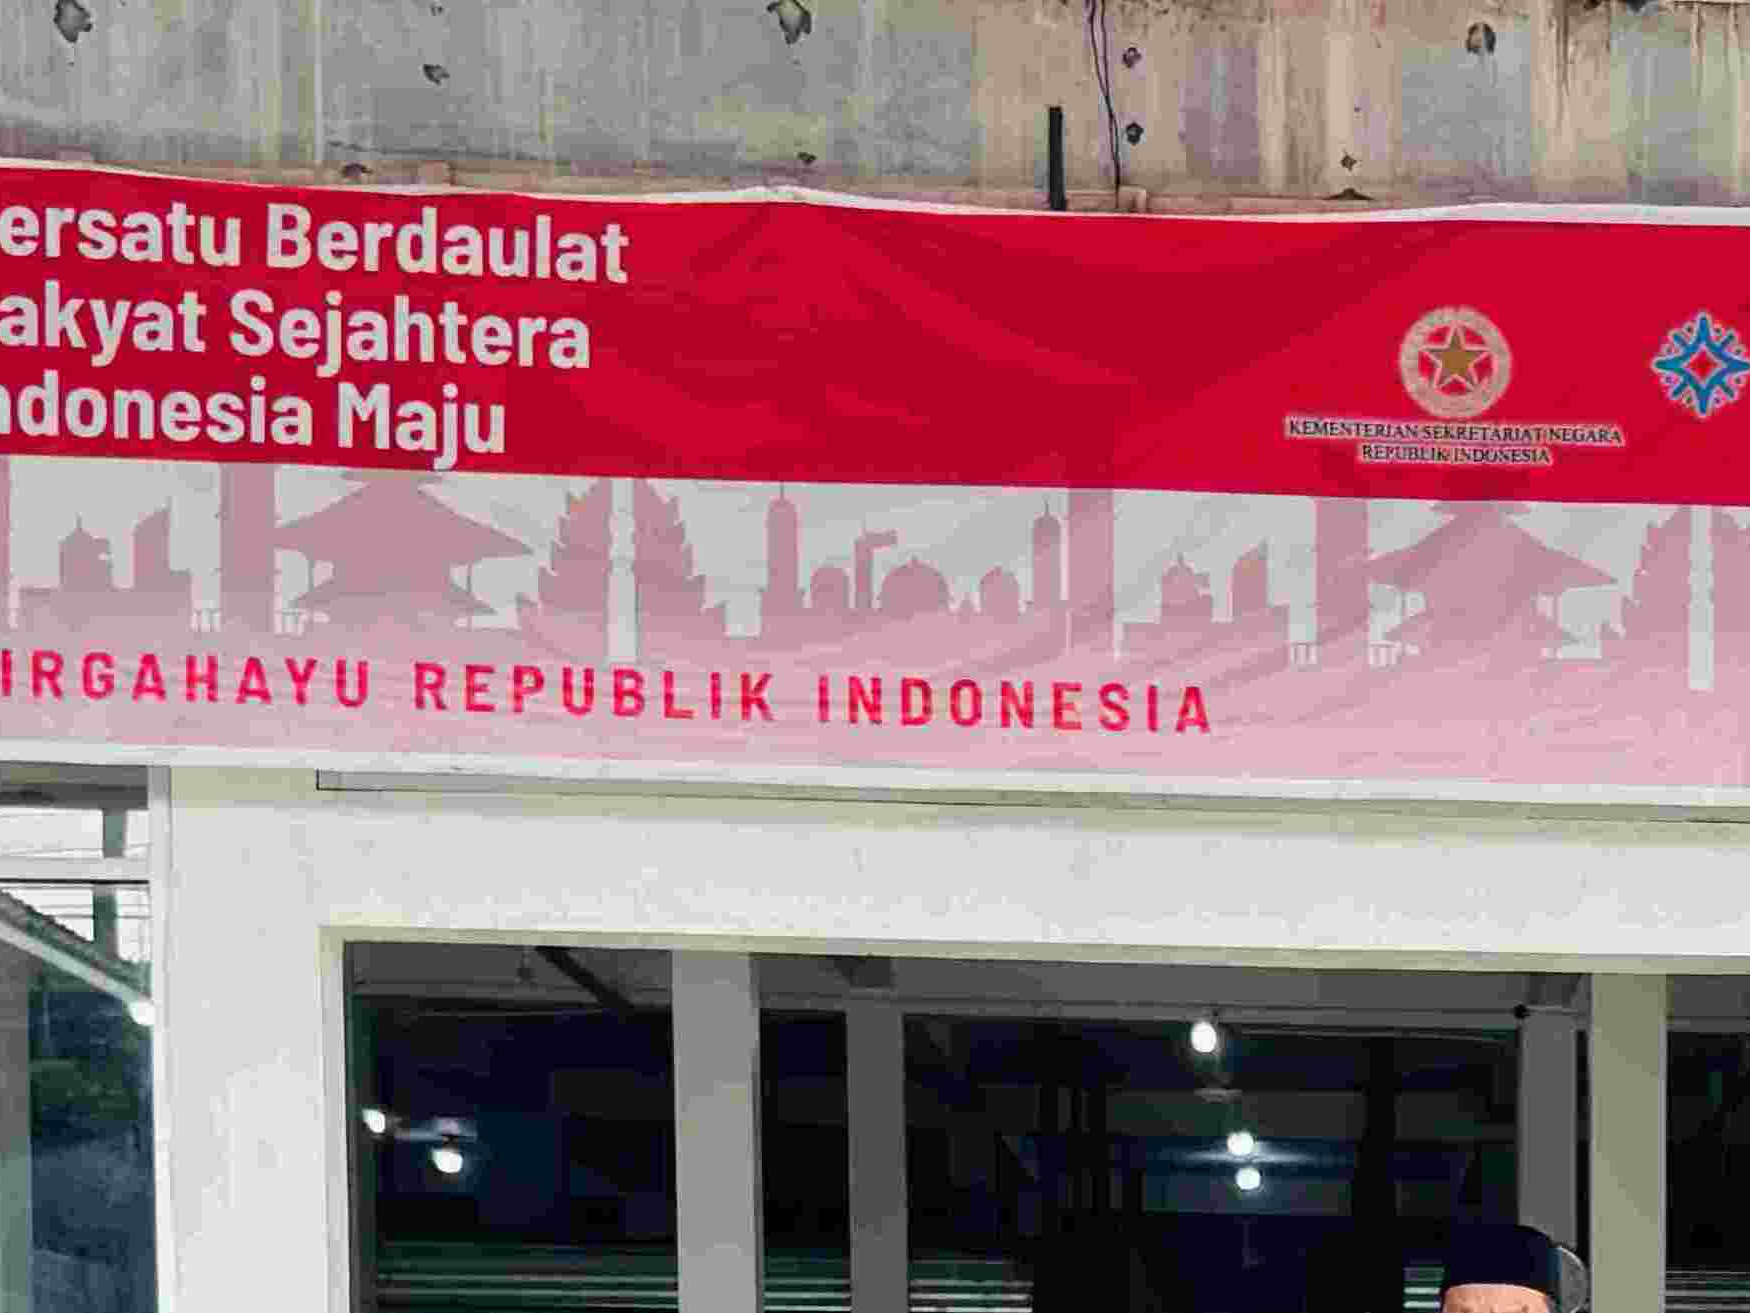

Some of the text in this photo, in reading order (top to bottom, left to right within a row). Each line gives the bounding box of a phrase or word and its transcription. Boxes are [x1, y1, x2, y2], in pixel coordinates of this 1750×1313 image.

[265, 202, 630, 284] Berdaulat
[228, 288, 591, 378] Sejahtera
[337, 381, 506, 471] Maju
[1288, 419, 1623, 444] KEMENTERIAN SEKRETARIAT NEGARA
[1361, 444, 1551, 464] REPUBLIK INDONESIA
[412, 660, 775, 721] REPUBLIK
[817, 672, 1212, 734] INDONESIA
